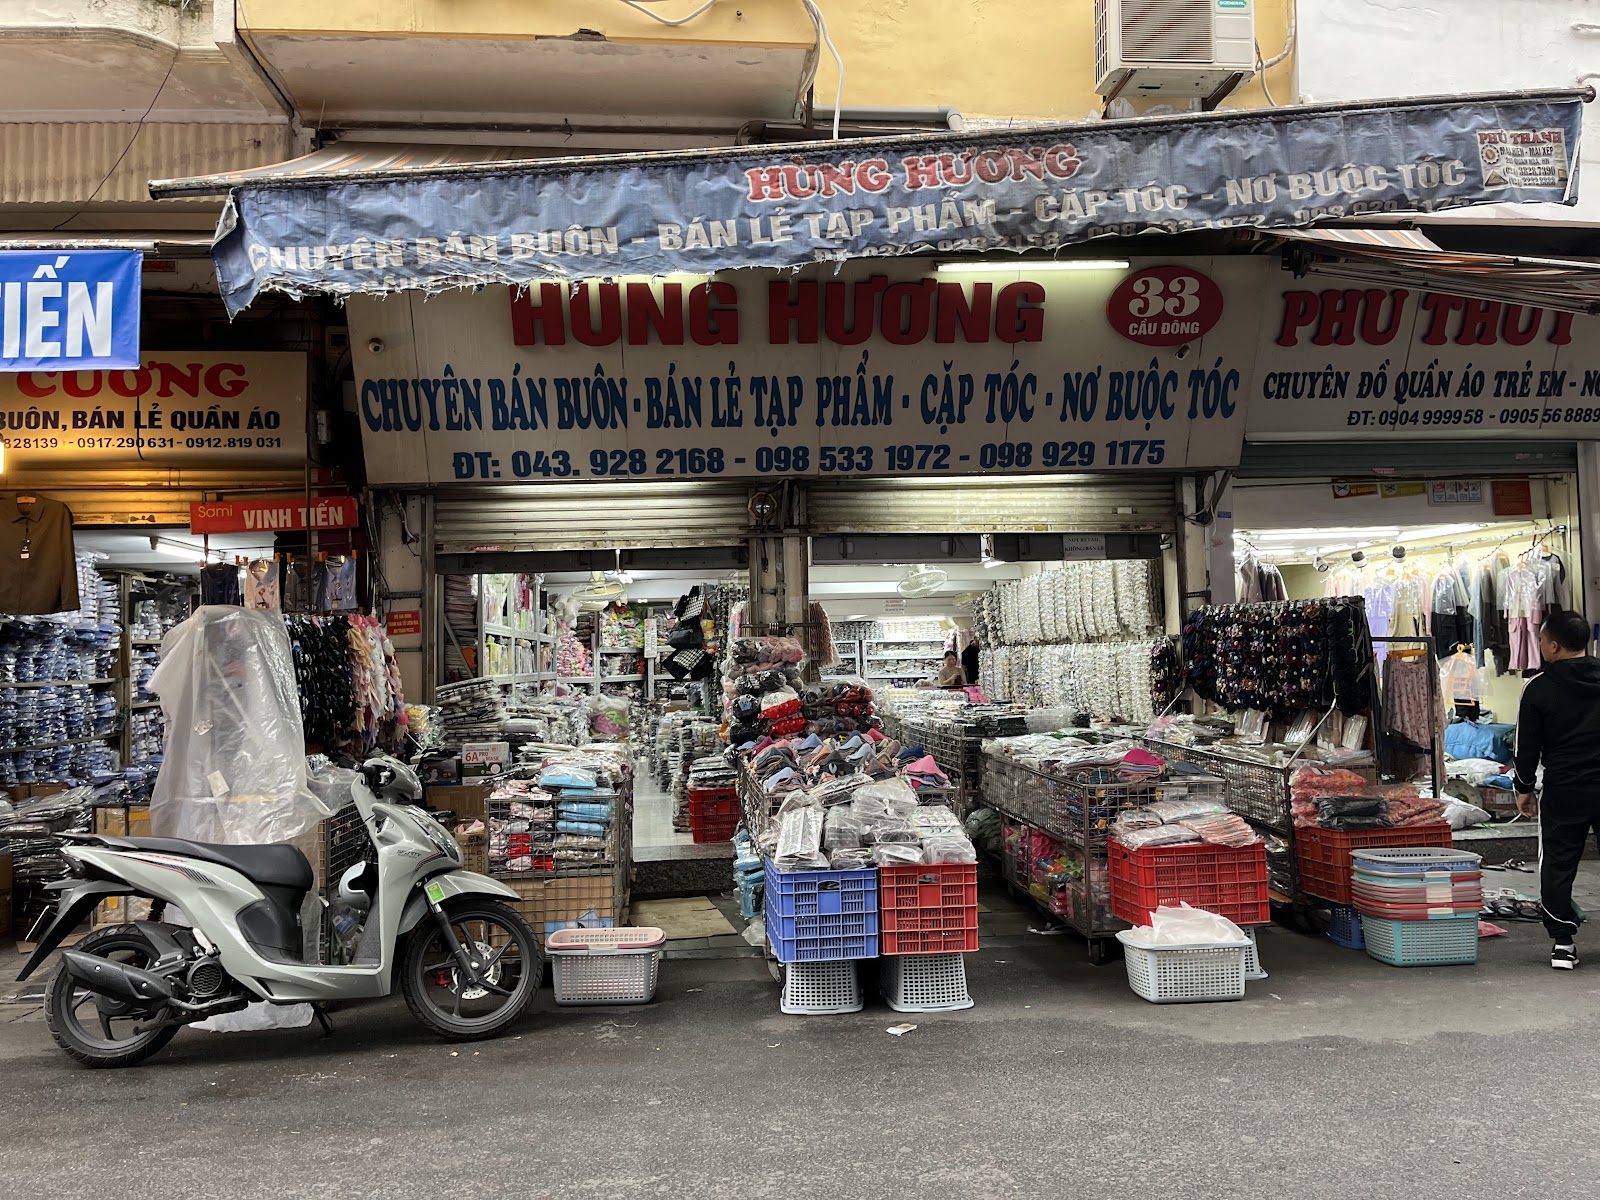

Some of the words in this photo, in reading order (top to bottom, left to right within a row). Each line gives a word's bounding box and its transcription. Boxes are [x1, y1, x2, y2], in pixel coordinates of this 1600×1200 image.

[745, 155, 893, 202] HÙNG
[902, 143, 1081, 191] HƯƠNG
[247, 237, 403, 272] CHUYÊN
[416, 231, 498, 265] BÁN
[511, 223, 618, 259] BUÔN
[657, 216, 738, 251] BÁN
[749, 206, 794, 244] LẺ
[803, 208, 875, 245] TẠP
[888, 190, 996, 234] PHẨM
[1035, 188, 1108, 225] CẶP
[1119, 180, 1188, 213] TÓC
[1226, 172, 1277, 206] NƠ
[1288, 163, 1388, 200] BUỘC
[1398, 156, 1466, 189] TÓC
[0, 256, 113, 358] IẾN
[768, 275, 1046, 346] HƯƠNG
[1128, 276, 1201, 317] 33
[1128, 318, 1158, 336] CẦU
[1160, 320, 1200, 335] ĐÔNG
[361, 363, 483, 432] CHUYÊN
[487, 362, 549, 431] BÁN
[556, 362, 628, 430] BUÔN
[645, 362, 702, 429] BÁN
[710, 360, 743, 429] LẺ
[750, 375, 804, 437] TẠP
[816, 349, 894, 427] PHẨM
[920, 359, 974, 435] CẶP
[984, 359, 1037, 424] TÓC
[1060, 365, 1102, 422] NƠ
[1105, 356, 1179, 432] BUỘC
[1187, 357, 1240, 420] TÓC
[1263, 363, 1350, 400] CHUYÊN
[1356, 359, 1391, 399] ĐỒ
[1394, 359, 1453, 404] QUẦN
[1456, 363, 1485, 398] ÁO
[1493, 360, 1532, 398] TRẺ
[1536, 370, 1567, 397] EM
[72, 406, 125, 430] BÁN
[134, 402, 162, 430] LẺ
[170, 404, 240, 431] QUẦN
[247, 406, 280, 430] ÁO
[1422, 409, 1484, 425] 999958
[1500, 408, 1539, 424] 0905
[186, 437, 252, 449] 0912.819
[256, 437, 281, 449] 031
[453, 451, 501, 480] ĐT:
[511, 450, 580, 477] 043.
[590, 449, 647, 476] 928
[656, 447, 725, 475] 2168
[756, 446, 810, 473] 098
[820, 446, 873, 472] 533
[884, 444, 950, 470] 1972
[979, 442, 1033, 469] 098
[1042, 441, 1095, 467] 929
[1105, 440, 1165, 466] 1175
[243, 508, 292, 529] VINH
[298, 500, 344, 527] TIẾN
[465, 752, 478, 762] 6A
